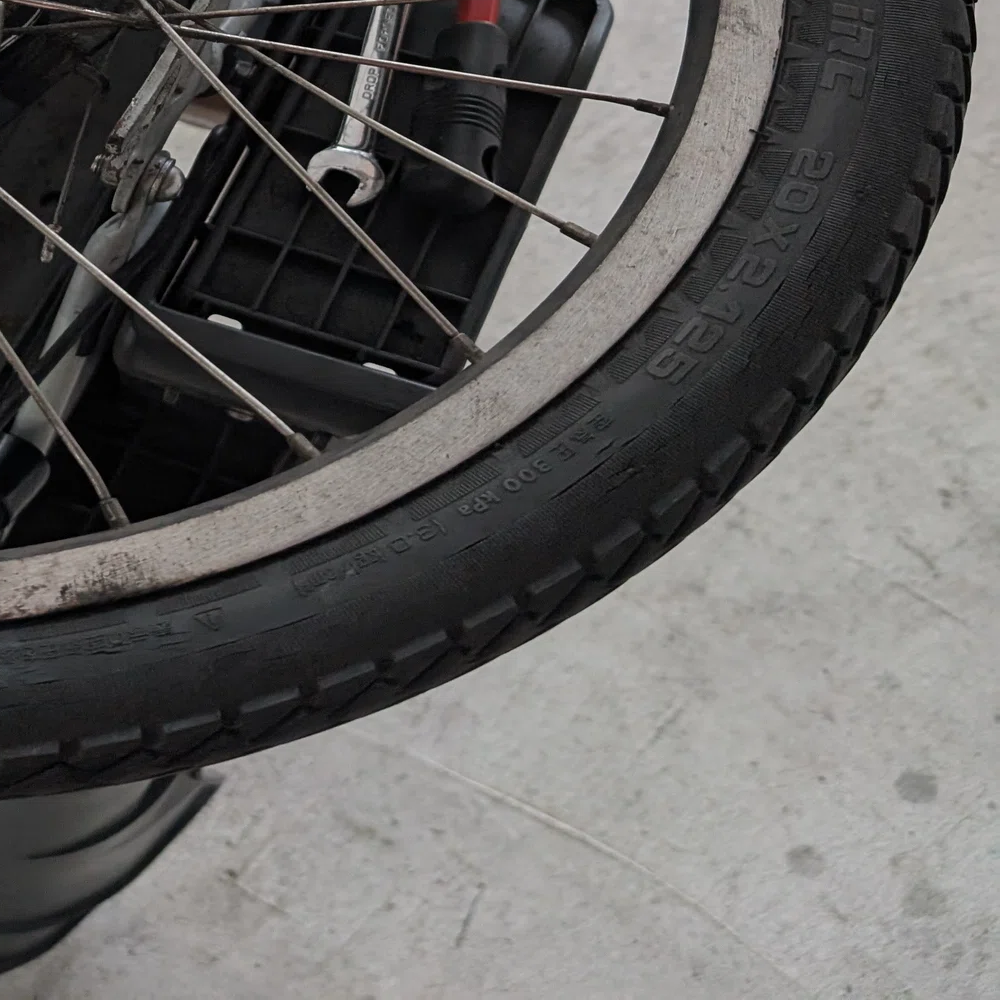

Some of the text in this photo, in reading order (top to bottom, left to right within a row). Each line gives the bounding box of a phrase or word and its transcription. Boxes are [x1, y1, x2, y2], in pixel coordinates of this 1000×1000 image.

[361, 67, 380, 101] DROP
[505, 458, 554, 495] 300
[458, 489, 500, 518] kPa
